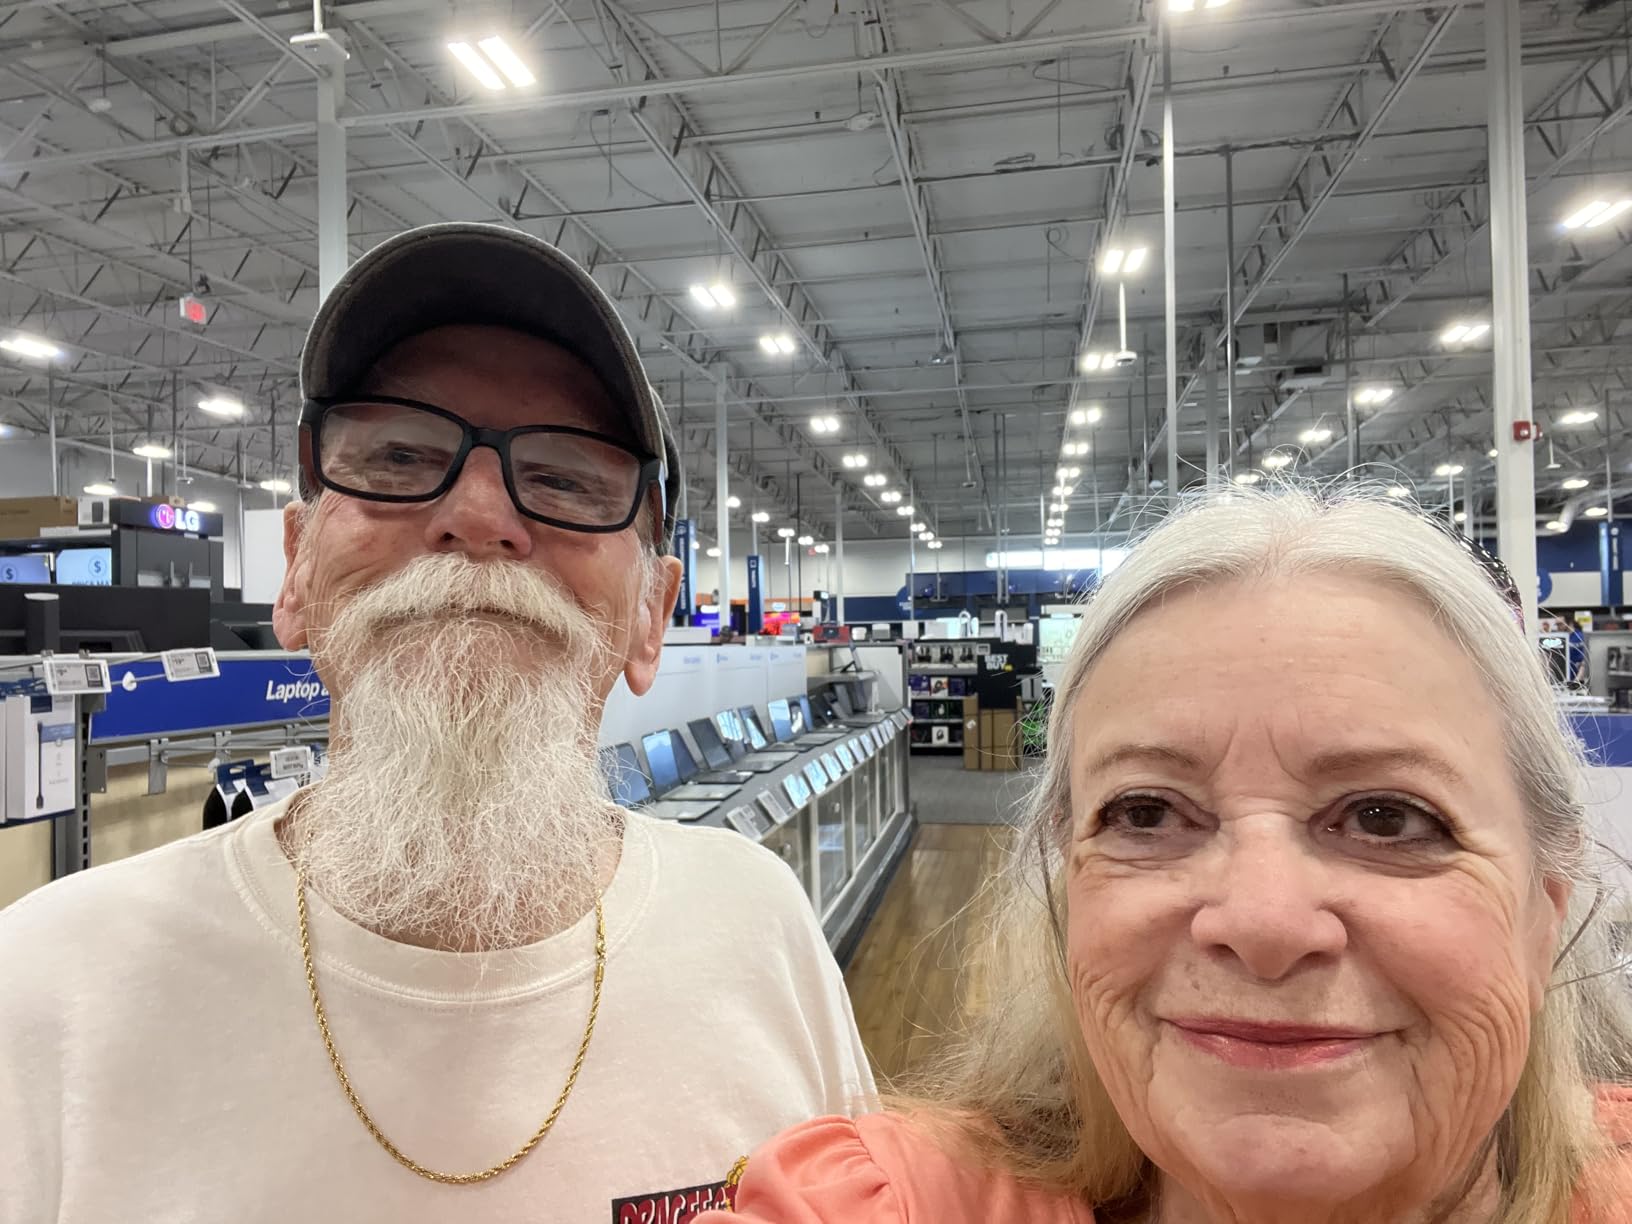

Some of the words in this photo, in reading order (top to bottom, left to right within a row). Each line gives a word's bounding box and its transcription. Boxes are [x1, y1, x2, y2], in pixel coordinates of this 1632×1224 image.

[175, 508, 200, 531] LG
[266, 679, 320, 703] Laptop
[321, 687, 329, 697] a
